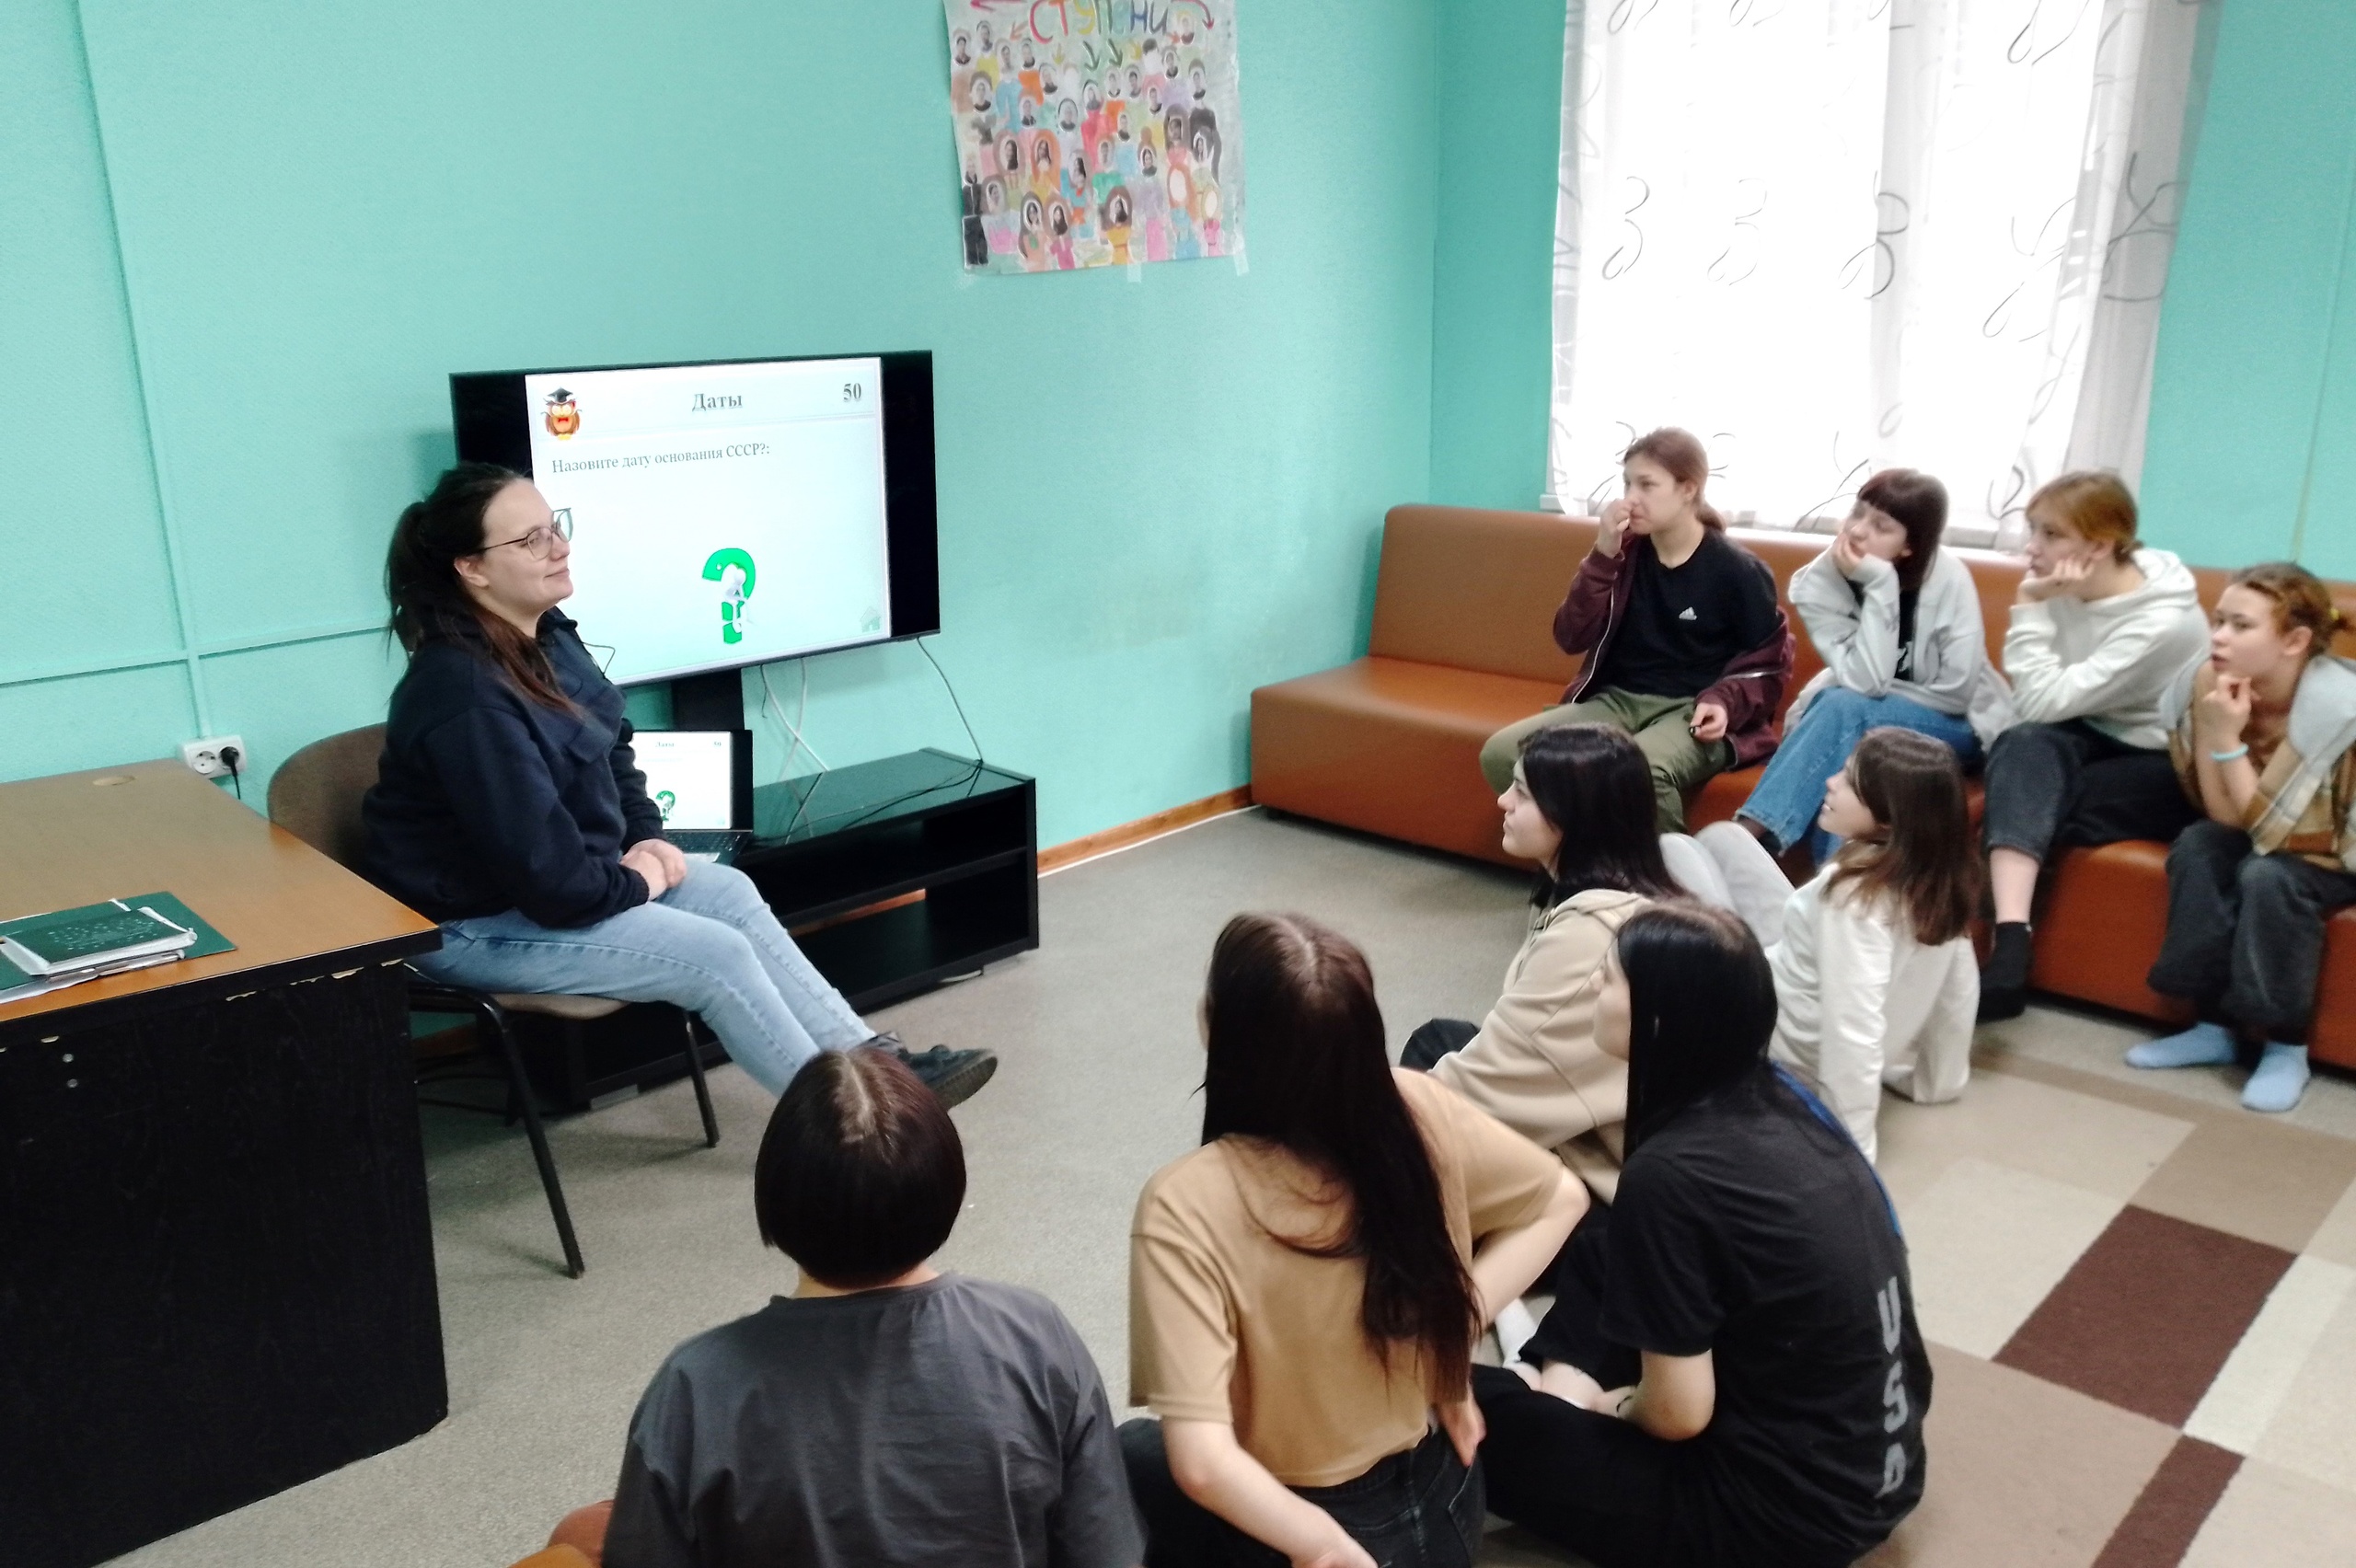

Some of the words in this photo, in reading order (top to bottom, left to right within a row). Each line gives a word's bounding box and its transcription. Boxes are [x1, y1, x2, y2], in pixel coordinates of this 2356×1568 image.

[843, 383, 862, 402] 50
[692, 393, 743, 412] Даты
[552, 458, 619, 474] Назовите
[622, 455, 653, 468] дату
[654, 448, 723, 465] основания
